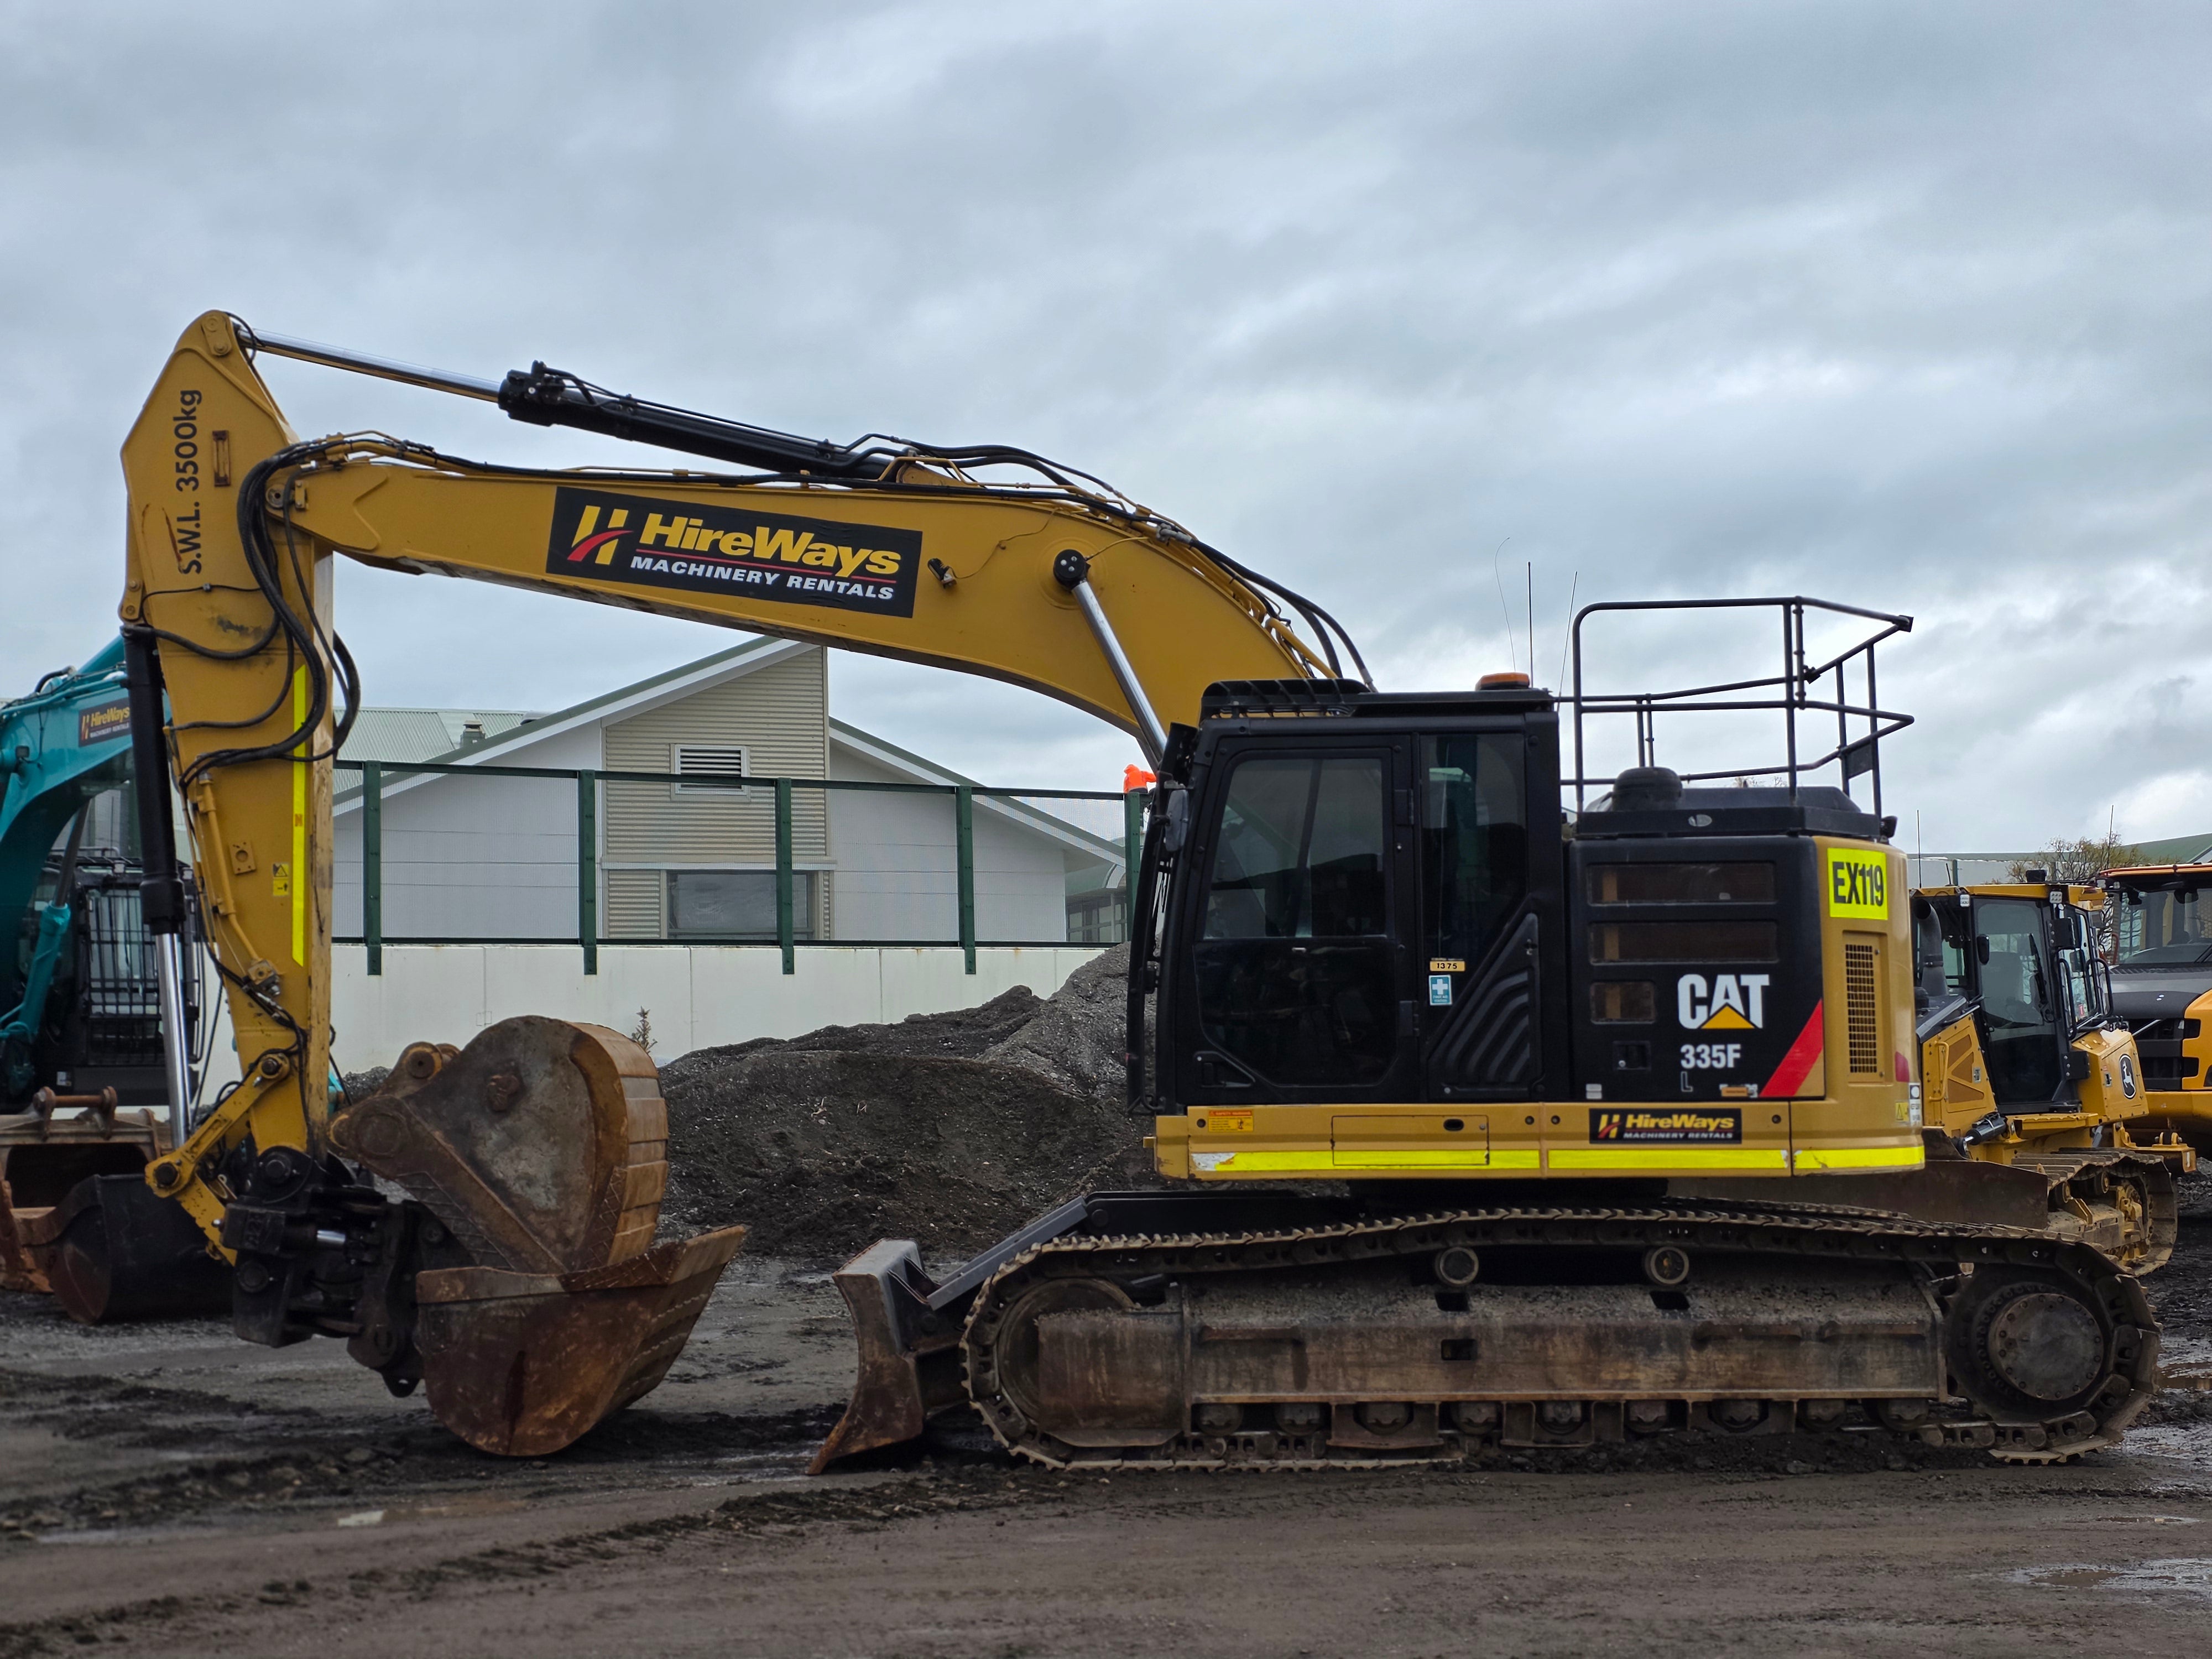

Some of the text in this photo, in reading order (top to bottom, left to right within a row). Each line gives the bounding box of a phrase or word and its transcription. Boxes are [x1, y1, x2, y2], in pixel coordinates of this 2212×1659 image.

[173, 390, 202, 575] S.W.L. 3500kg
[639, 513, 901, 578] HireWays
[630, 556, 895, 600] MACHINERY RENTALS
[90, 706, 130, 727] HireWays
[1832, 861, 1885, 907] EX119
[1677, 973, 1770, 1030] CAT
[1680, 1044, 1741, 1069] 335F
[1681, 1071, 1694, 1092] L
[1625, 1114, 1735, 1132] HireWays
